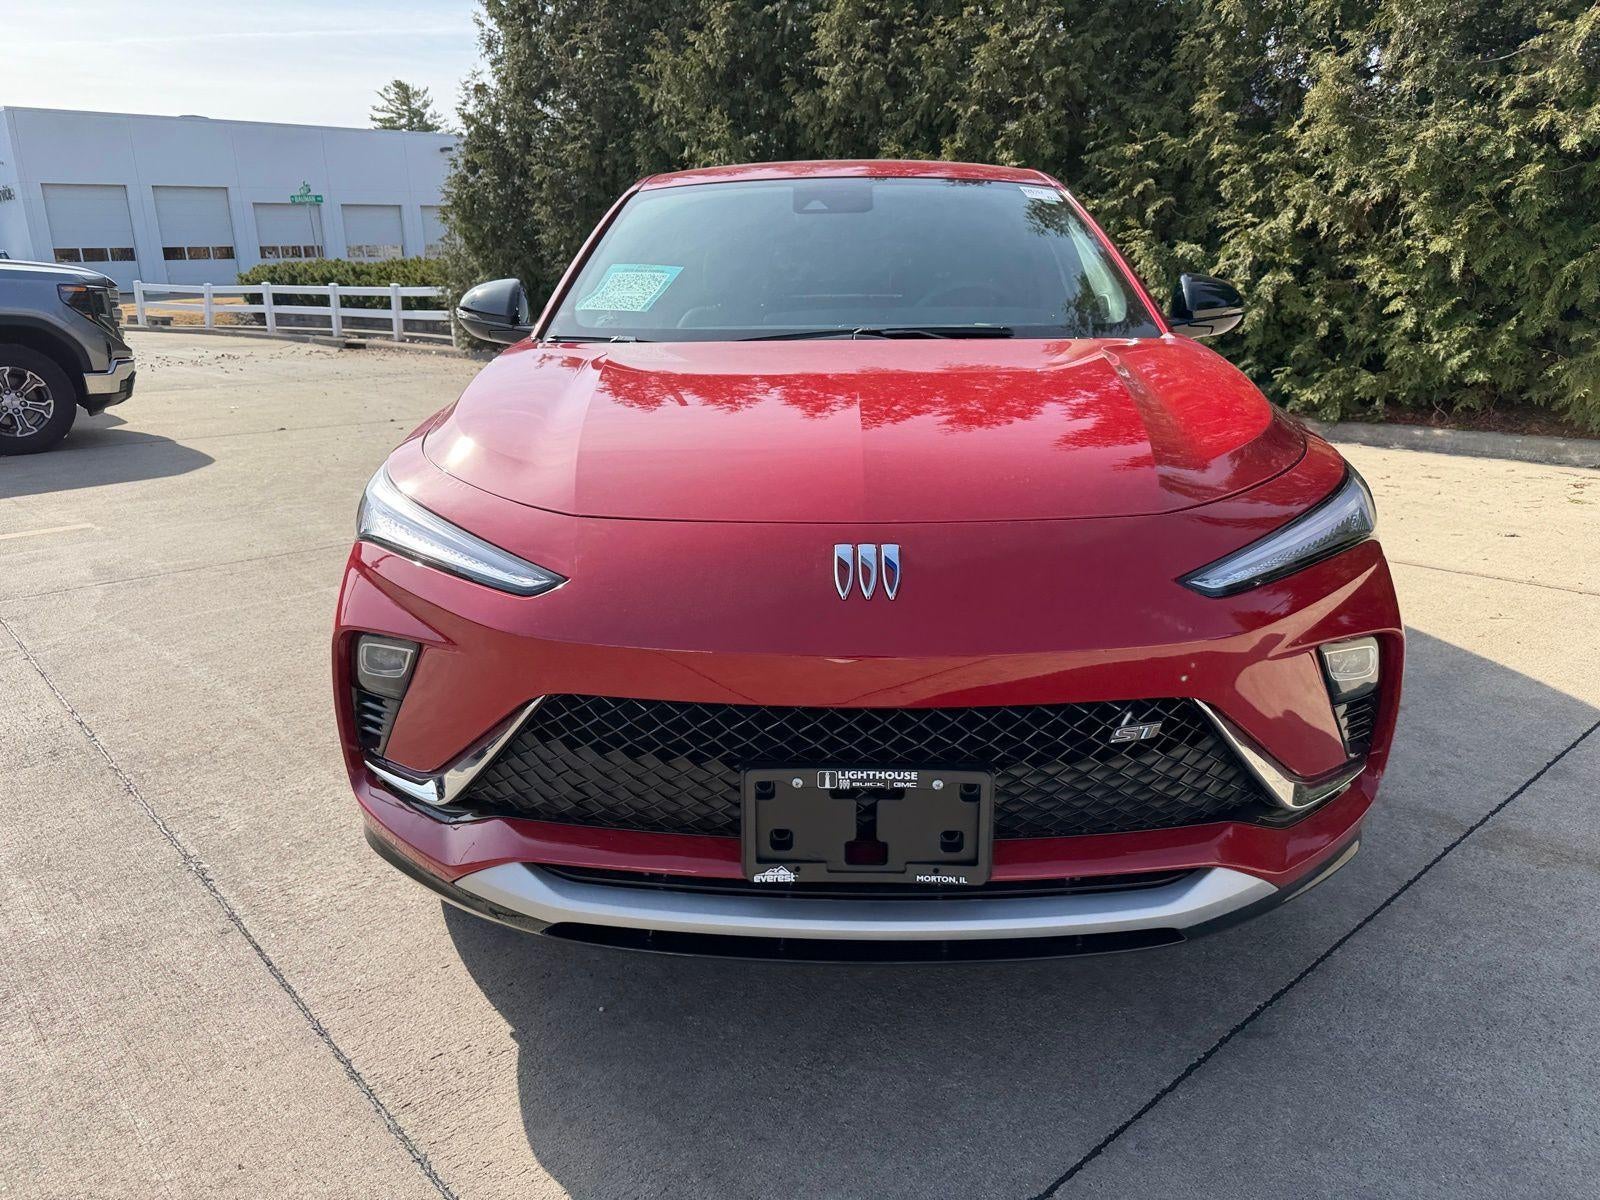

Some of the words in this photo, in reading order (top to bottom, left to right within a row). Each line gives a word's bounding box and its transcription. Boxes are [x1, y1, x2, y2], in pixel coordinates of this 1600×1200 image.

[1109, 721, 1162, 743] ST
[838, 770, 918, 780] LIGHTHOUSE
[753, 873, 796, 883] everest
[916, 875, 958, 884] MORTON,
[959, 876, 968, 884] IL
